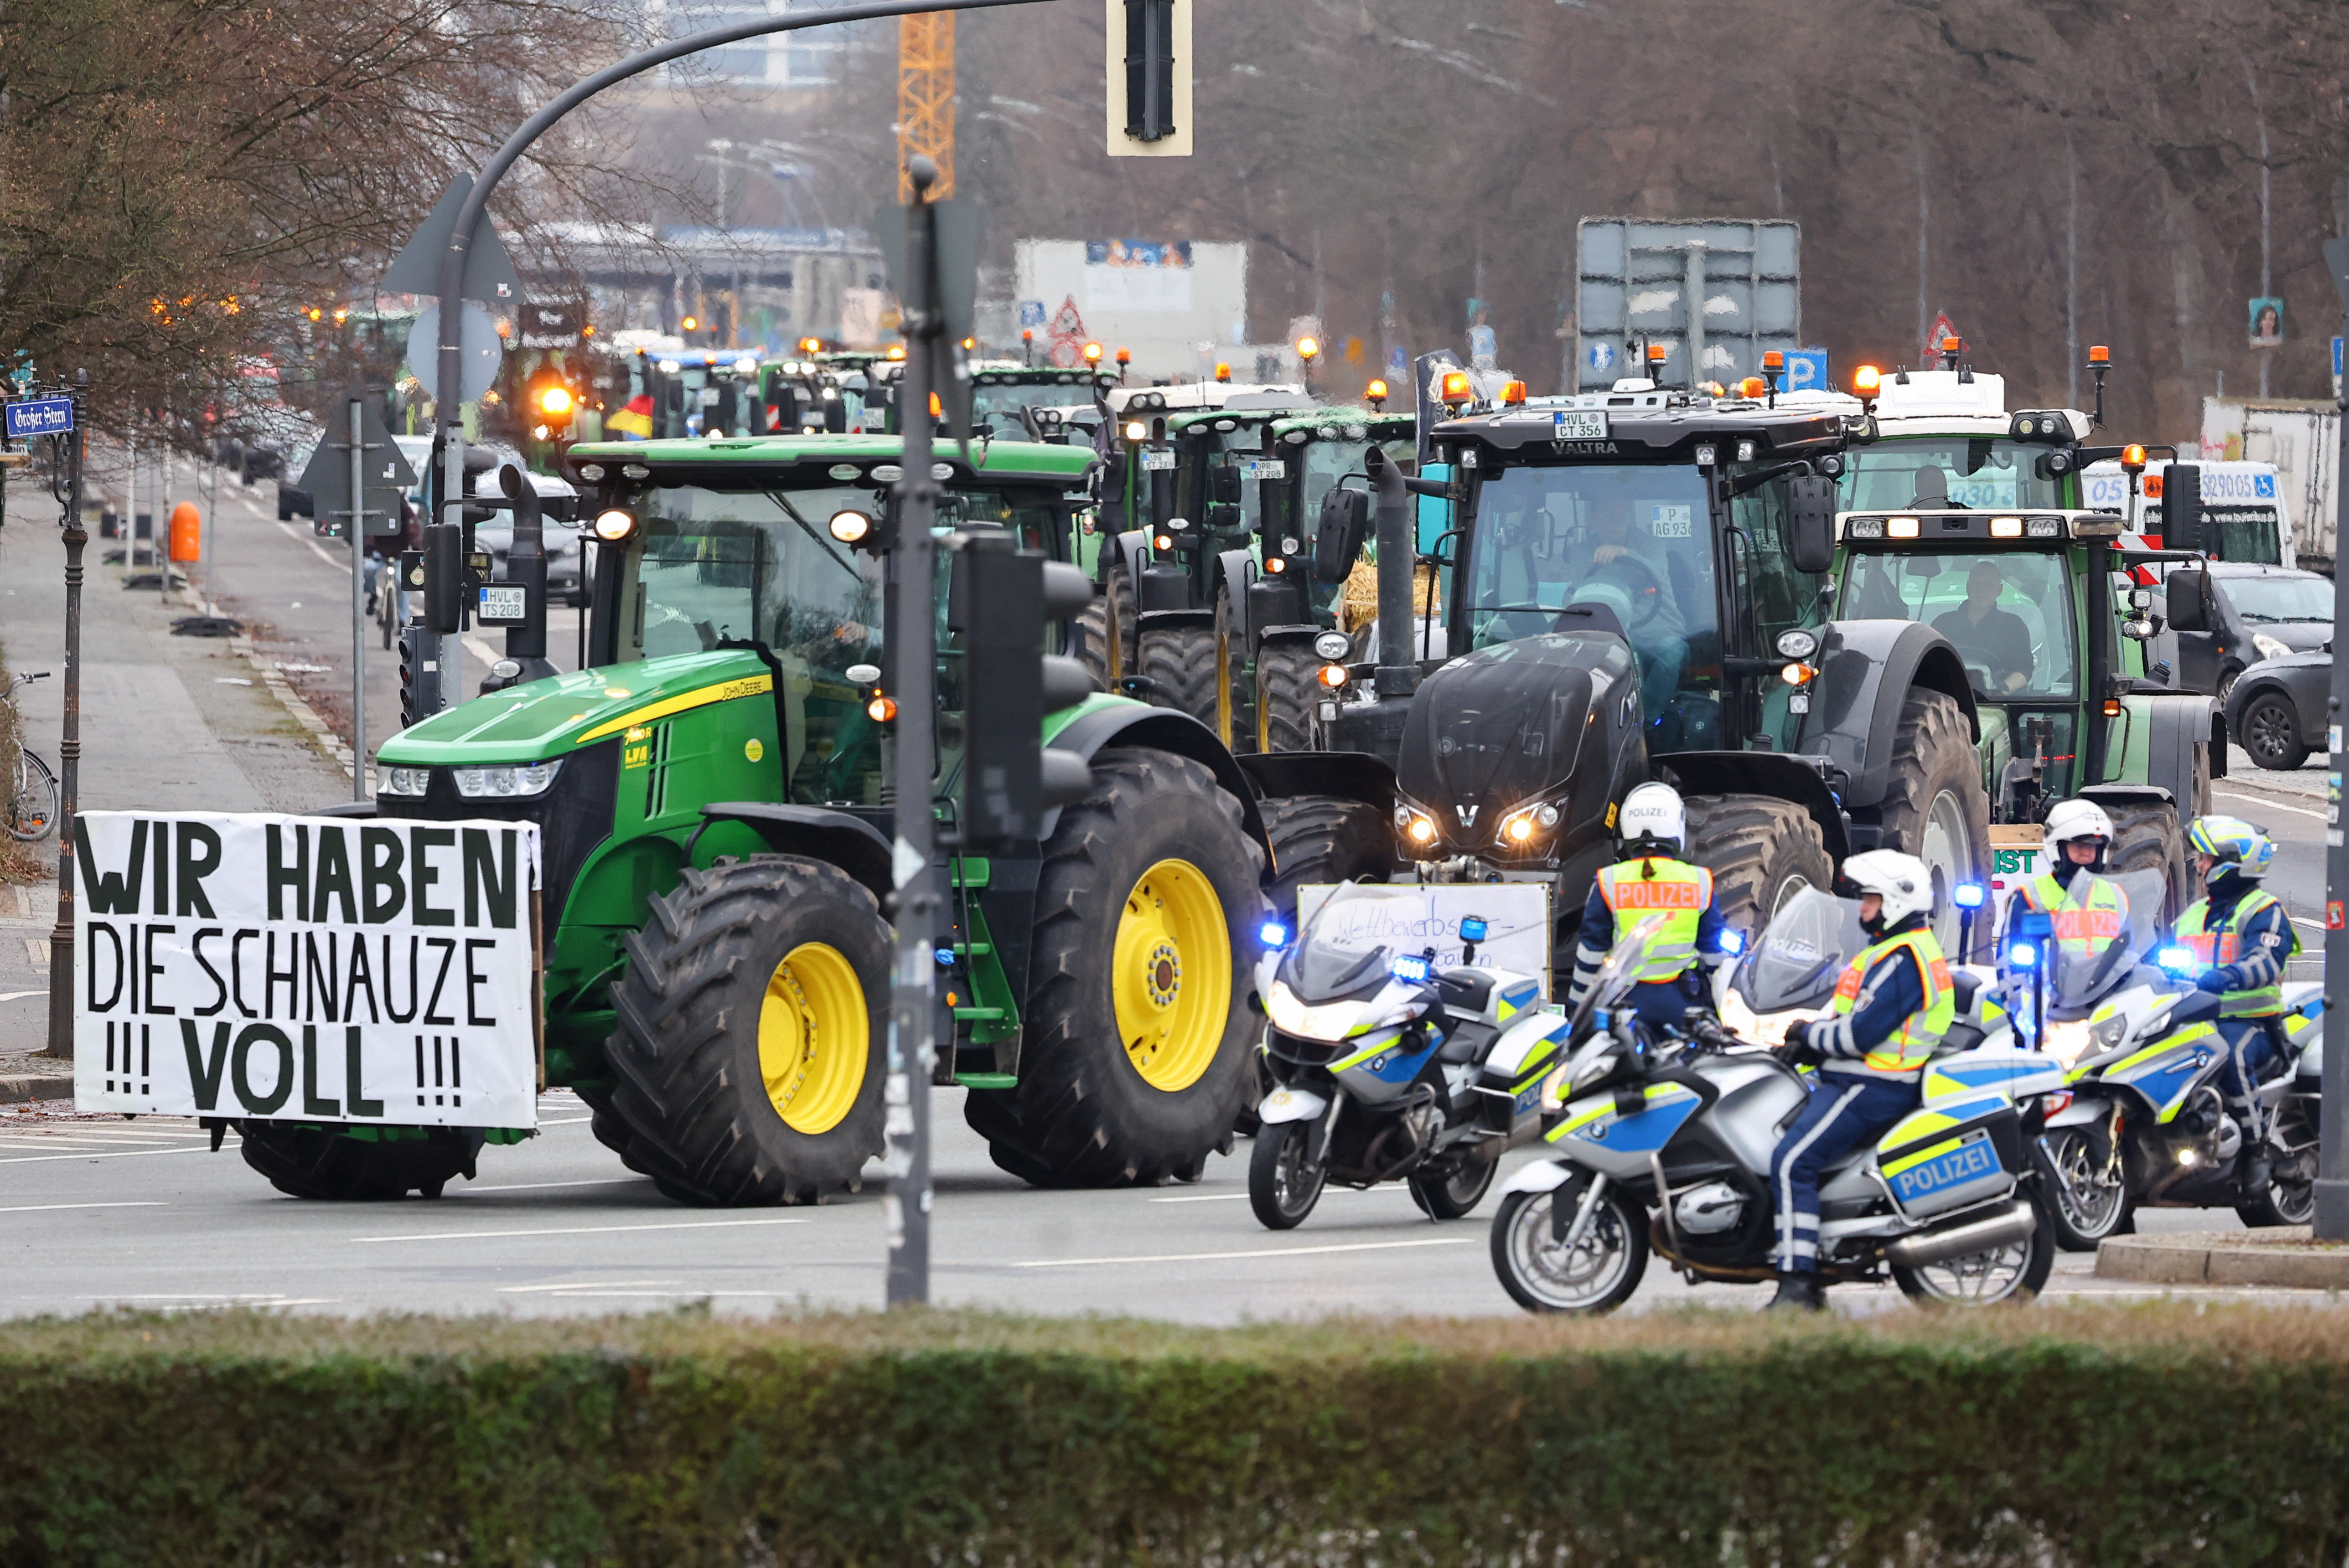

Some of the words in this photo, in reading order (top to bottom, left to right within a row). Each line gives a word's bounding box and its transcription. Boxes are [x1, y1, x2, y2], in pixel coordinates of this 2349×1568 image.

[1789, 357, 1815, 392] P
[15, 407, 42, 430] Großer
[44, 406, 66, 427] Stern
[1563, 414, 1586, 425] HVL
[1560, 426, 1575, 436] CT
[1579, 425, 1601, 436] 356
[1551, 441, 1618, 454] VALTRA
[1953, 485, 1995, 505] 030
[1668, 509, 1676, 521] P
[1656, 523, 1670, 536] AG
[490, 591, 511, 602] HVL
[484, 604, 497, 616] TS
[500, 604, 520, 616] 208
[1629, 808, 1667, 817] POLIZEI
[74, 816, 222, 919] WIR
[265, 823, 517, 929] HABEN
[1619, 883, 1698, 908] POLIZEI
[88, 921, 176, 1016] DIE
[192, 928, 496, 1026] SCHNAUZE
[106, 1021, 150, 1095] !!!
[180, 1018, 384, 1117] VOLL
[415, 1035, 461, 1108] !!!
[1899, 1146, 1991, 1196] POLIZEI
